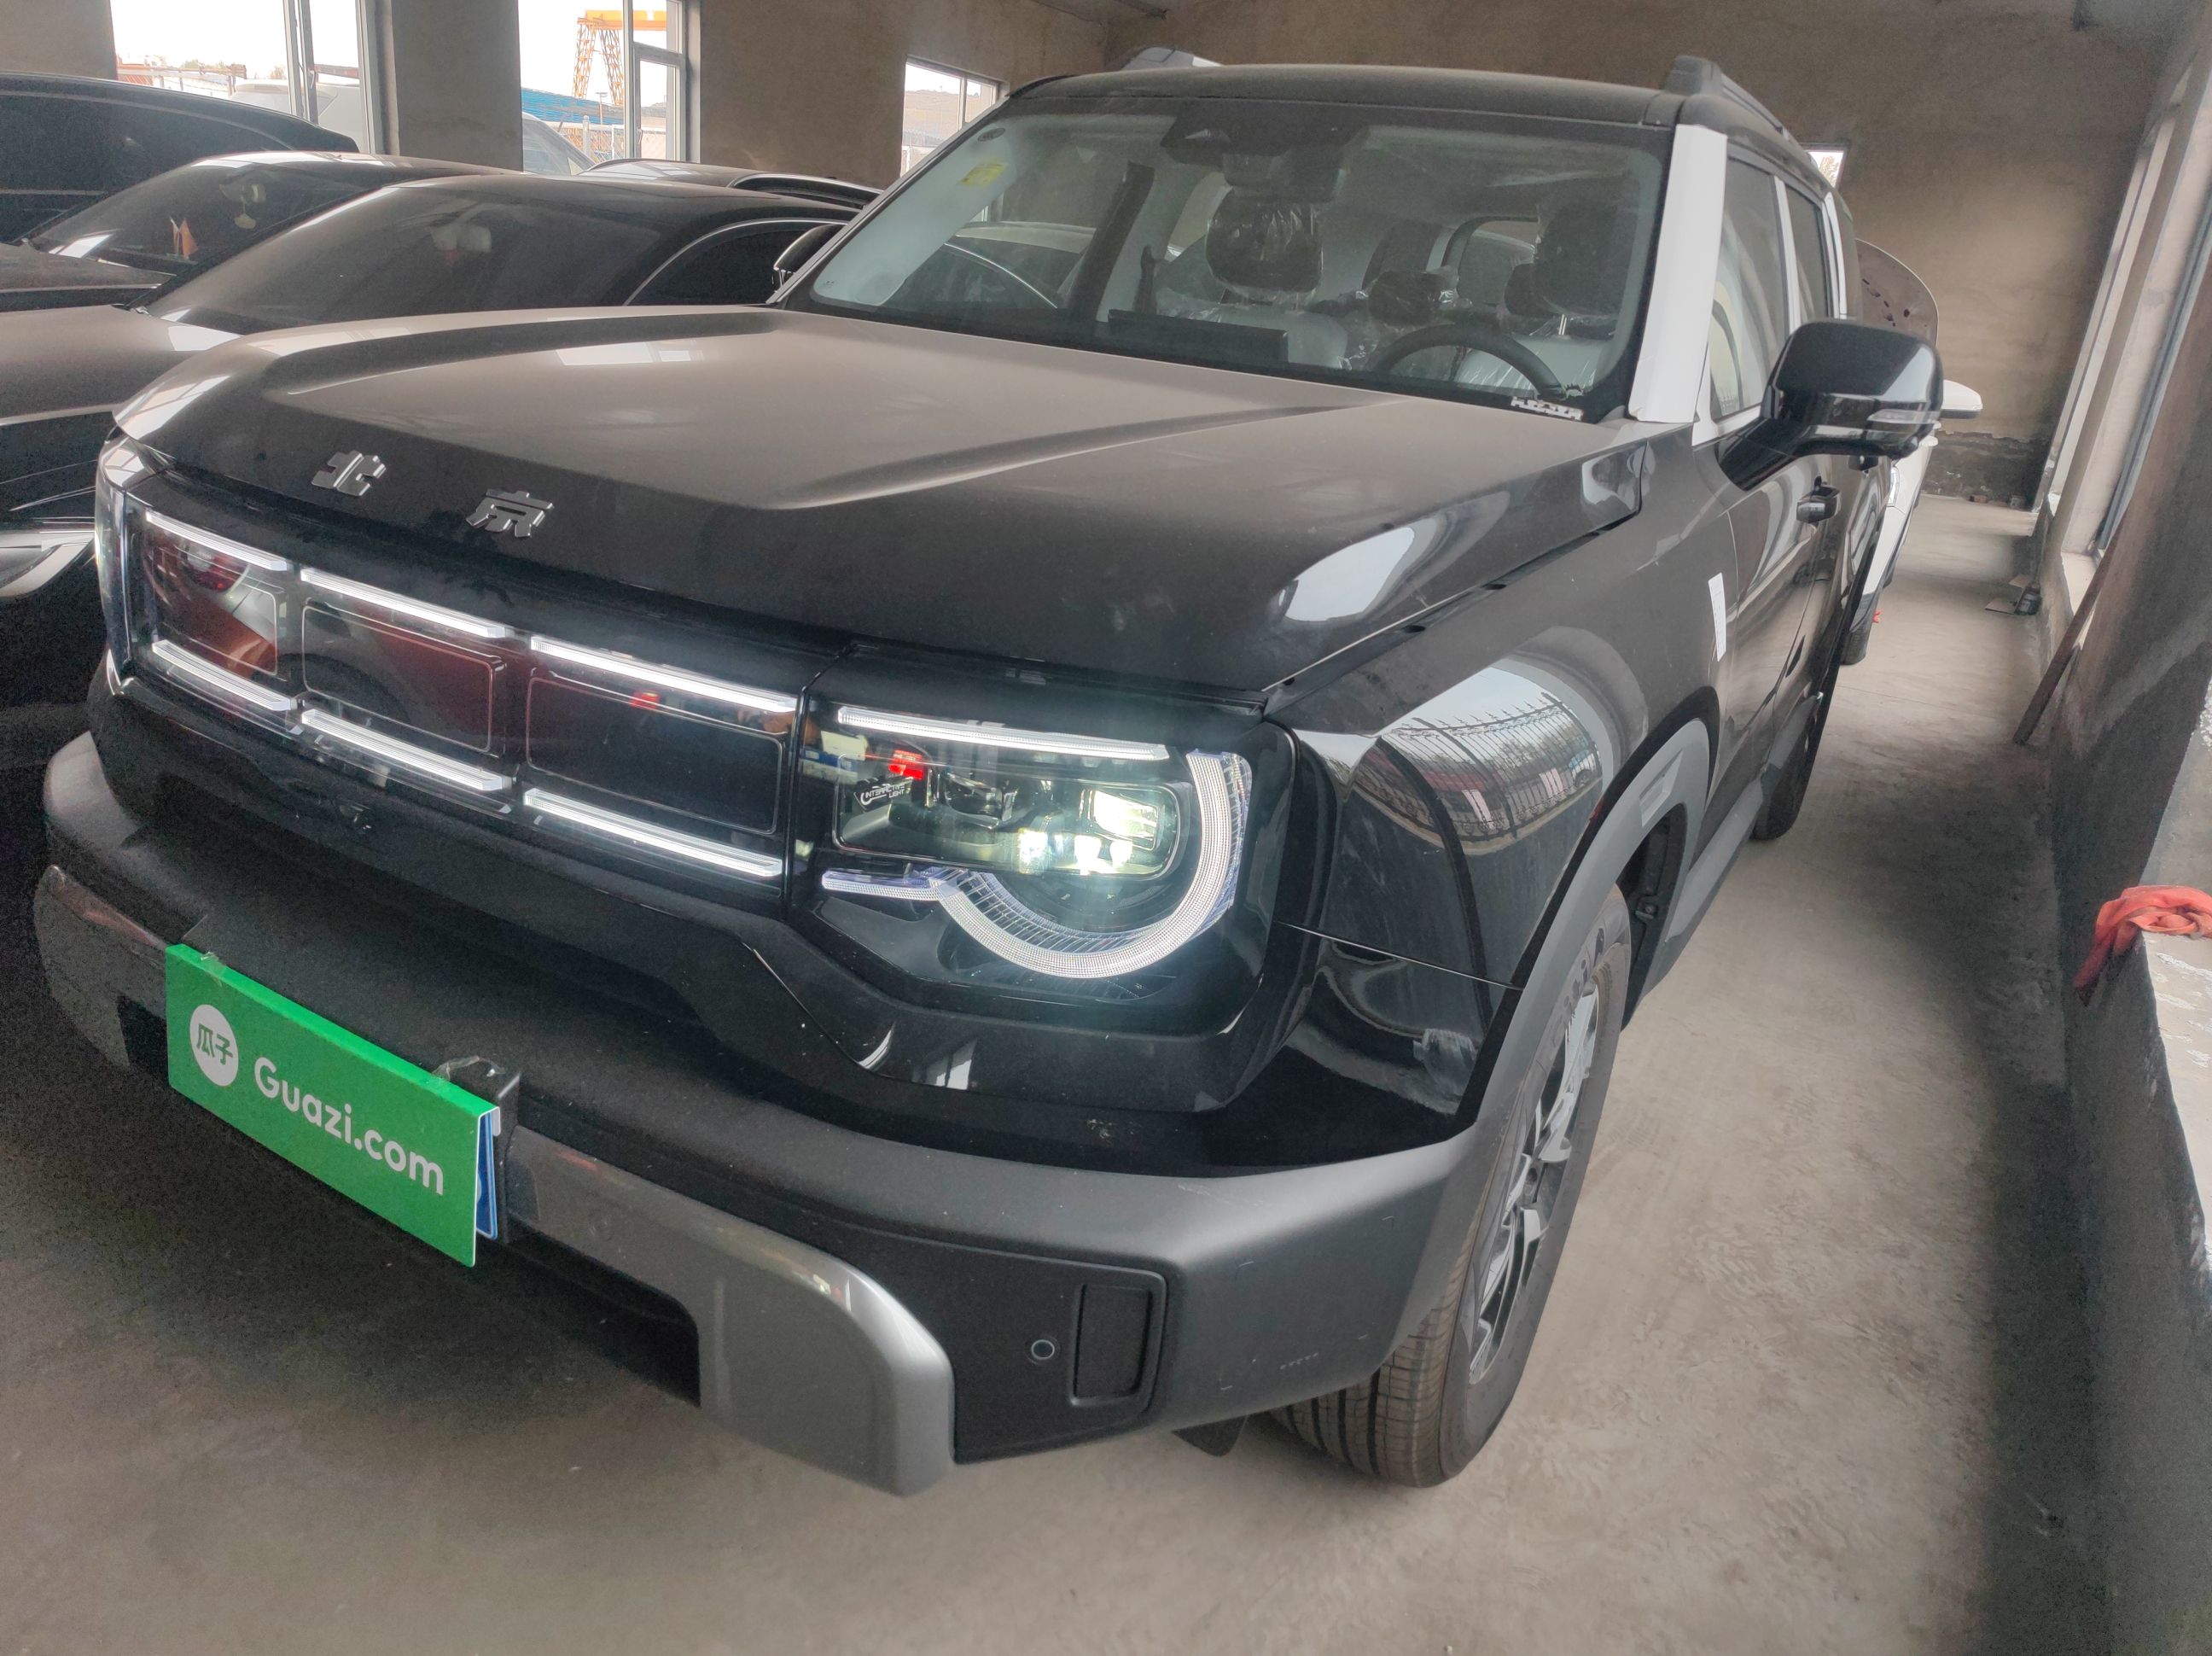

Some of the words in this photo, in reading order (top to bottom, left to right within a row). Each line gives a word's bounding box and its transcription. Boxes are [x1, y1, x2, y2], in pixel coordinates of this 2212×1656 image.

[311, 450, 554, 538] 北京
[888, 788, 905, 798] LIGHT
[196, 1023, 233, 1065] 瓜子
[254, 1057, 444, 1196] Guazi.com
